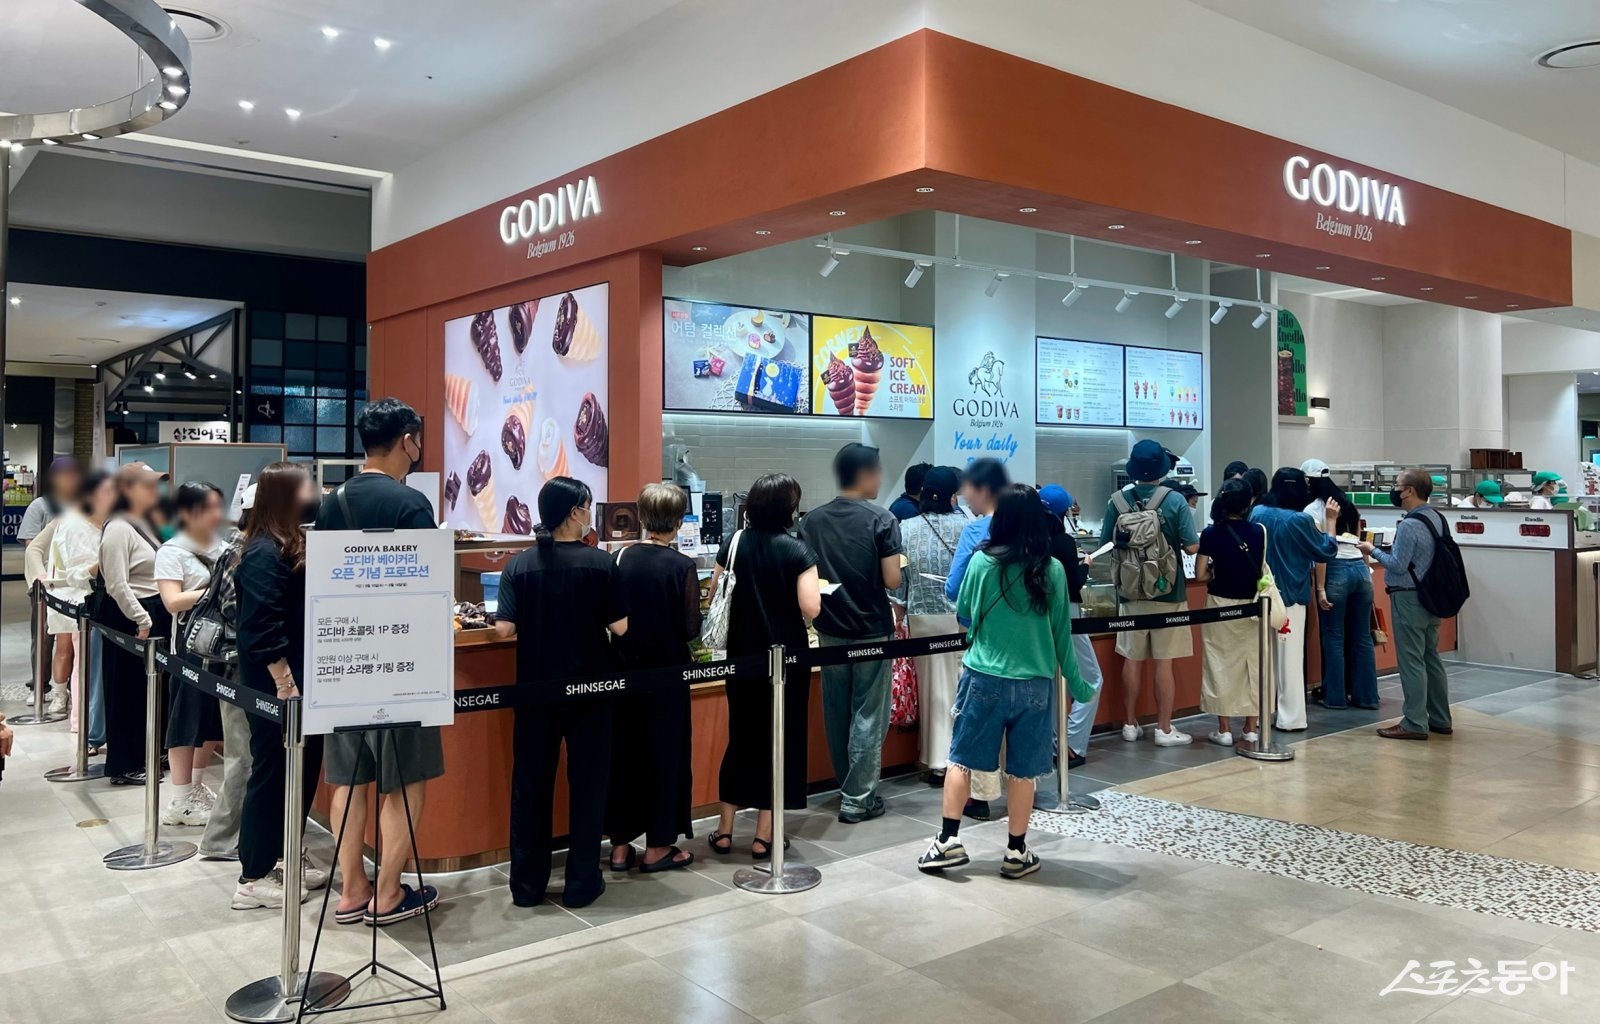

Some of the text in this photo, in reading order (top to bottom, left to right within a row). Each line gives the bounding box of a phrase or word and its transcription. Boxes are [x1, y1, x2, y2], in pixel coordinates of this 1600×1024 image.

[1282, 155, 1406, 226] GODIVA
[499, 175, 602, 244] GODIVA
[1316, 212, 1373, 242] Belgium 1926
[527, 230, 575, 259] Belgium 1926
[671, 320, 737, 341] 어텀 컬렉션
[890, 356, 915, 368] SOFT
[890, 370, 905, 381] ICE
[890, 383, 926, 395] CREAM
[953, 398, 1019, 419] GODIVA
[970, 418, 991, 428] Belgium
[173, 427, 227, 443] 삼진어묵
[953, 431, 1018, 458] Your daily
[383, 545, 418, 553] BAKERY
[343, 553, 418, 566] 고디바 베이커리
[331, 565, 429, 580] 오픈 기념 프로모션
[317, 616, 359, 626] 모든 구매 시
[1166, 615, 1190, 624] SHINSEGAE
[1219, 609, 1242, 618] SHINSEGAE
[317, 624, 410, 637] 고디바 초콜릿 1P 증정
[1108, 620, 1135, 629] SHINSEGAE
[929, 639, 962, 650] SHINSEGAE
[316, 653, 379, 664] 3만원 이상 구매 시
[847, 647, 884, 658] SHINSEGAE
[181, 666, 199, 683] SHINSEGAE
[316, 661, 414, 676] 고디바 소라빵 키링 증정
[682, 665, 736, 680] SHINSEGAE
[215, 682, 237, 700] SHINSEGAE
[565, 679, 626, 695] SHINSEGAE
[255, 698, 280, 716] SHINSEGAE
